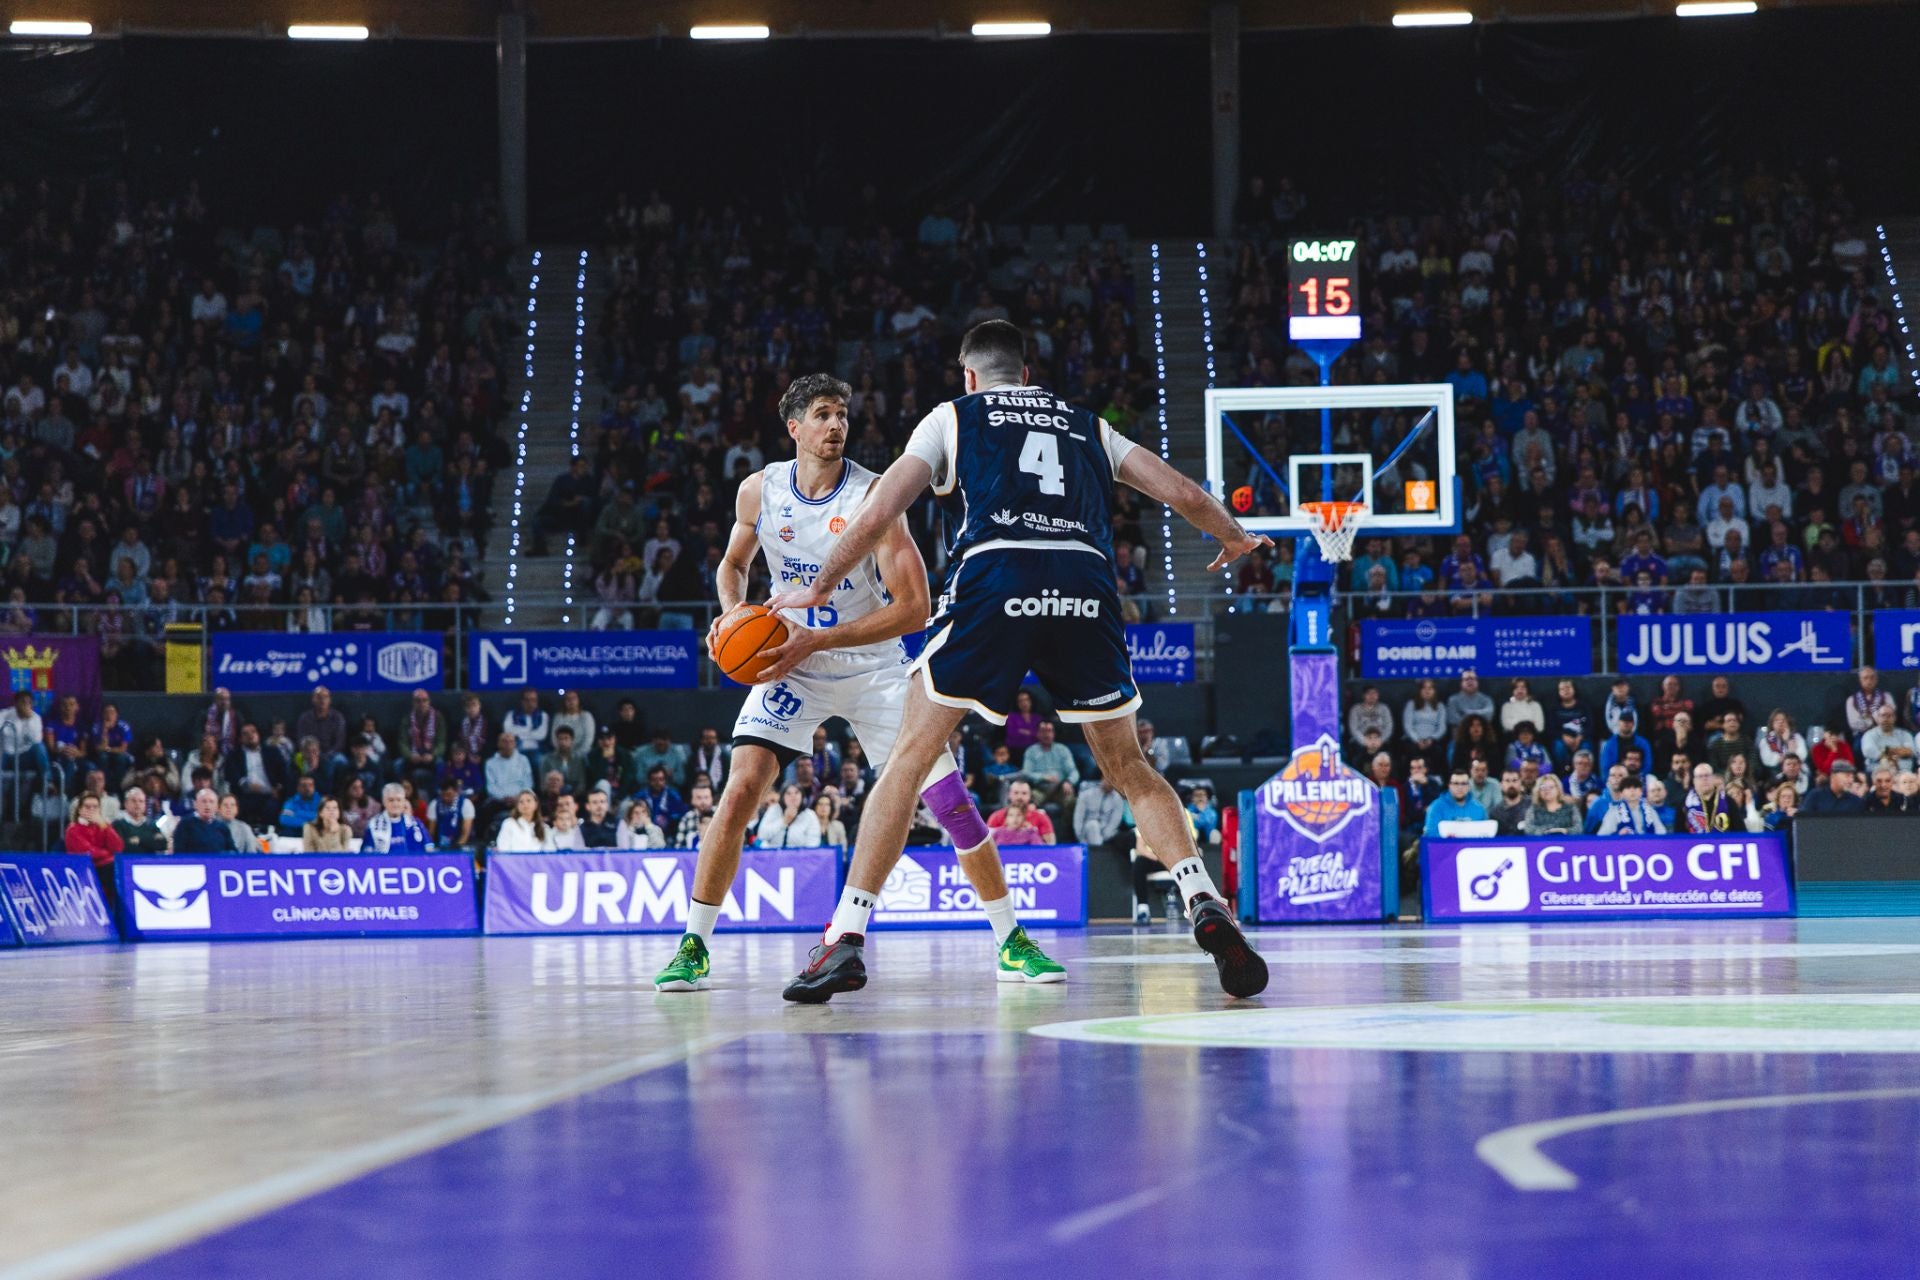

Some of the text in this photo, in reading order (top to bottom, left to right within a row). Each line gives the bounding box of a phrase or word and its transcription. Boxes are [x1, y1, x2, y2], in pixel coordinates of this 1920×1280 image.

[1293, 241, 1355, 262] 04:07
[1299, 277, 1351, 315] 15
[983, 394, 1052, 409] FAURE
[1018, 431, 1066, 497] 4
[1022, 512, 1089, 533] CAJA RURAL
[784, 561, 822, 573] agro
[806, 605, 839, 628] 15
[1377, 646, 1433, 661] DONDE
[1626, 621, 1773, 666] JULUIS
[1271, 779, 1365, 805] PALENCIA
[938, 862, 1058, 886] HEERO
[1287, 851, 1344, 878] JUEGA
[1536, 843, 1761, 892] Grupo CFI
[219, 866, 463, 898] DENTOMEDIC
[1277, 868, 1360, 898] PALENCIA
[1539, 889, 1763, 906] Ciberseguridad y Protección de datos
[343, 905, 419, 921] DENTALES
